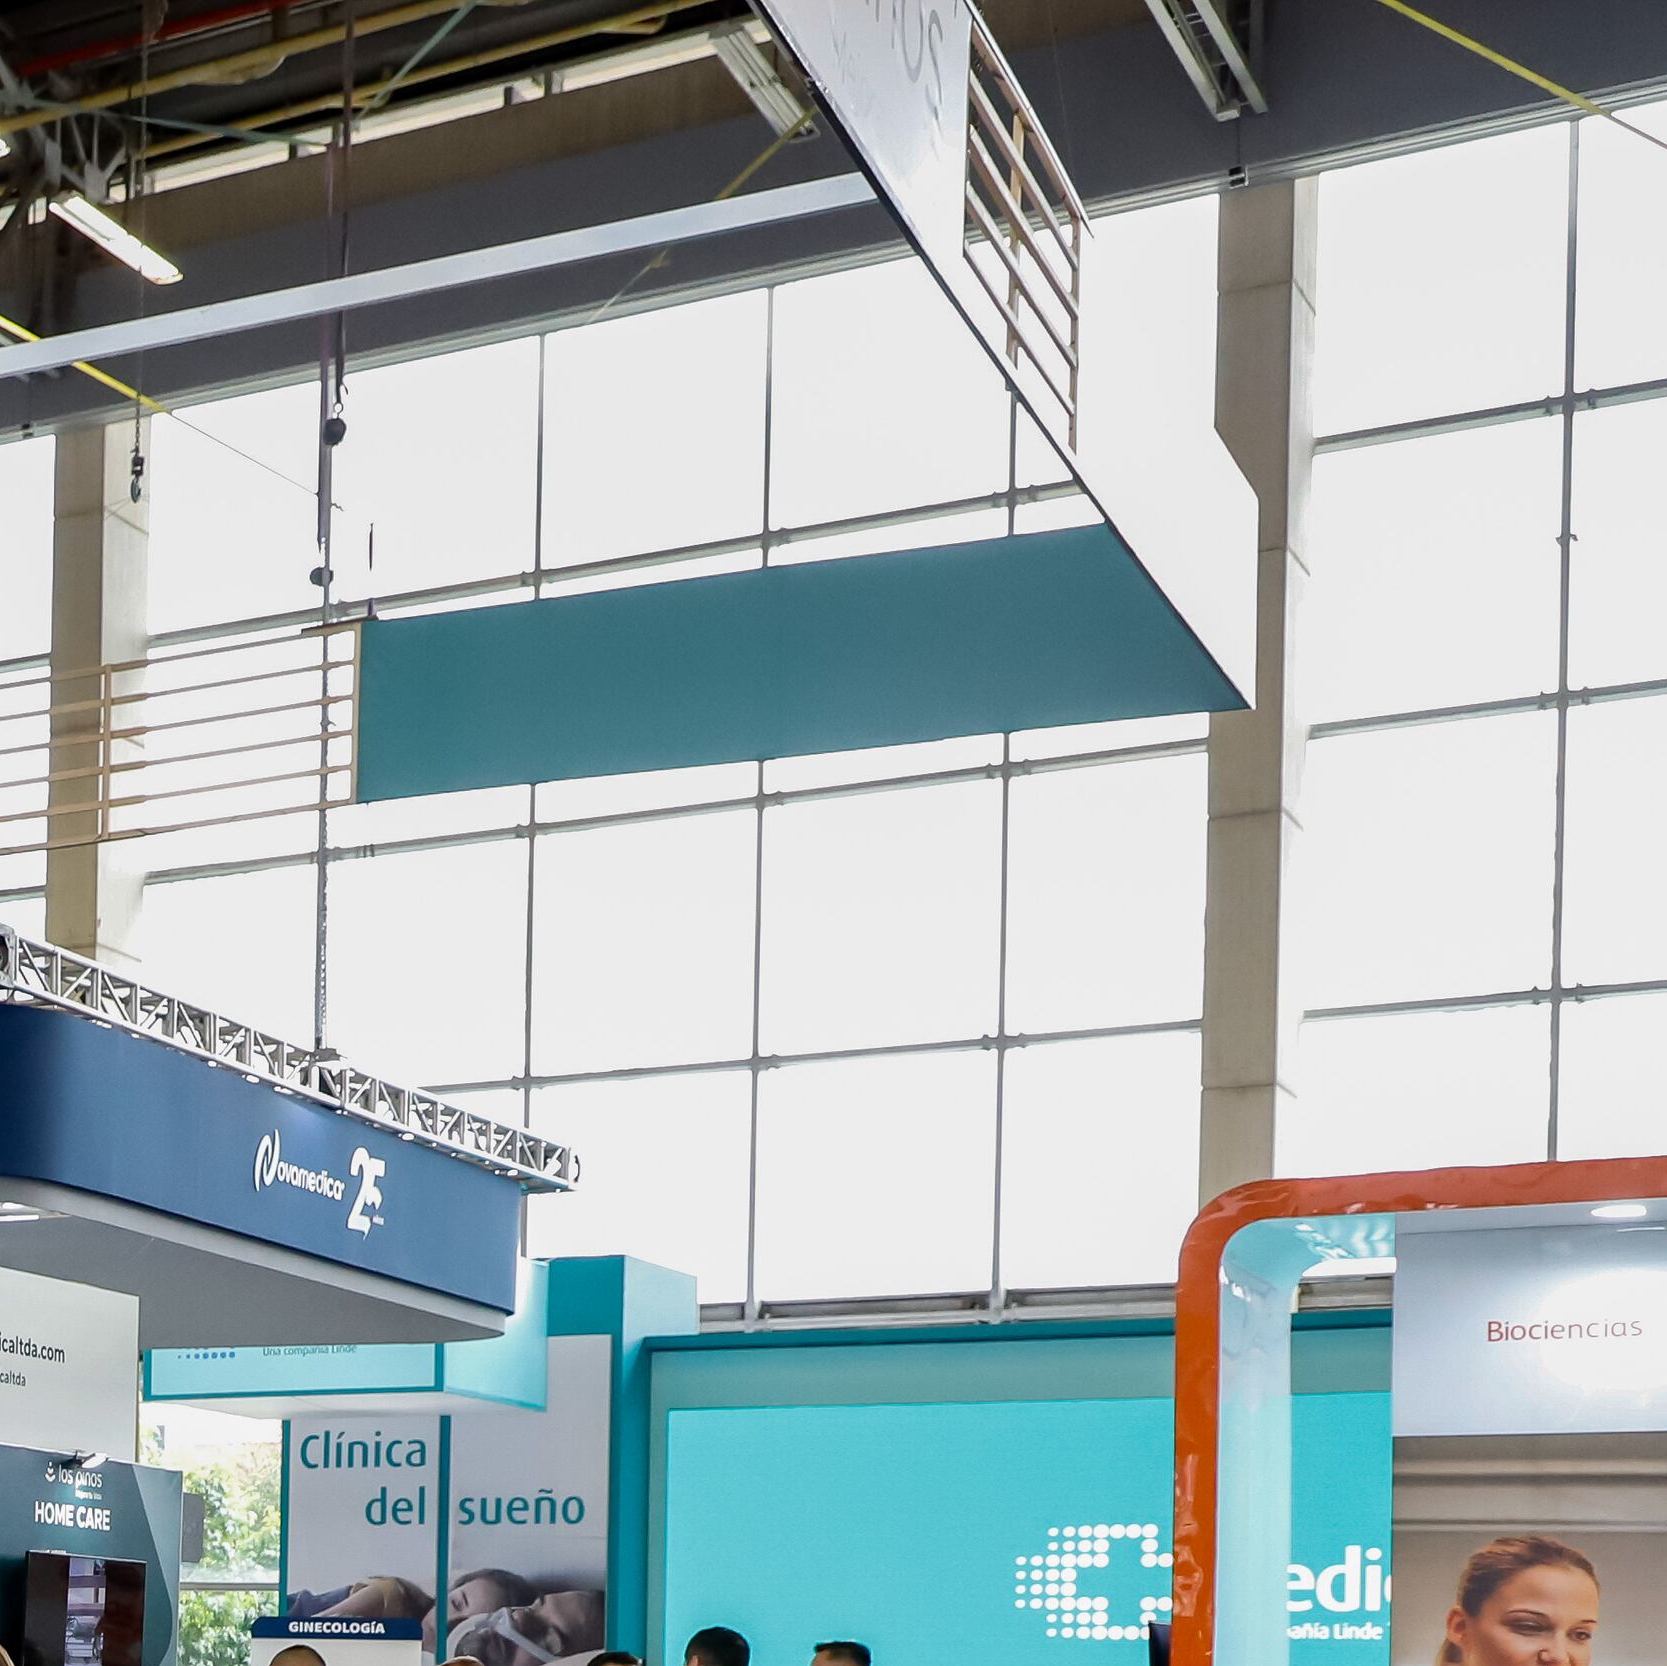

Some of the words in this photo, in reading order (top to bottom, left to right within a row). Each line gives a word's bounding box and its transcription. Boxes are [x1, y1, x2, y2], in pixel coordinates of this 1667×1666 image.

[254, 1128, 346, 1201] Novamedica
[347, 1147, 386, 1241] 25
[1486, 1318, 1644, 1343] Biociencias
[300, 1430, 428, 1469] Clínica
[58, 1464, 74, 1486] los
[75, 1470, 103, 1489] pinos
[34, 1500, 75, 1528] HOME
[76, 1505, 112, 1532] CARE
[365, 1485, 426, 1526] del
[457, 1488, 585, 1525] sueño
[1332, 1620, 1384, 1640] Linde
